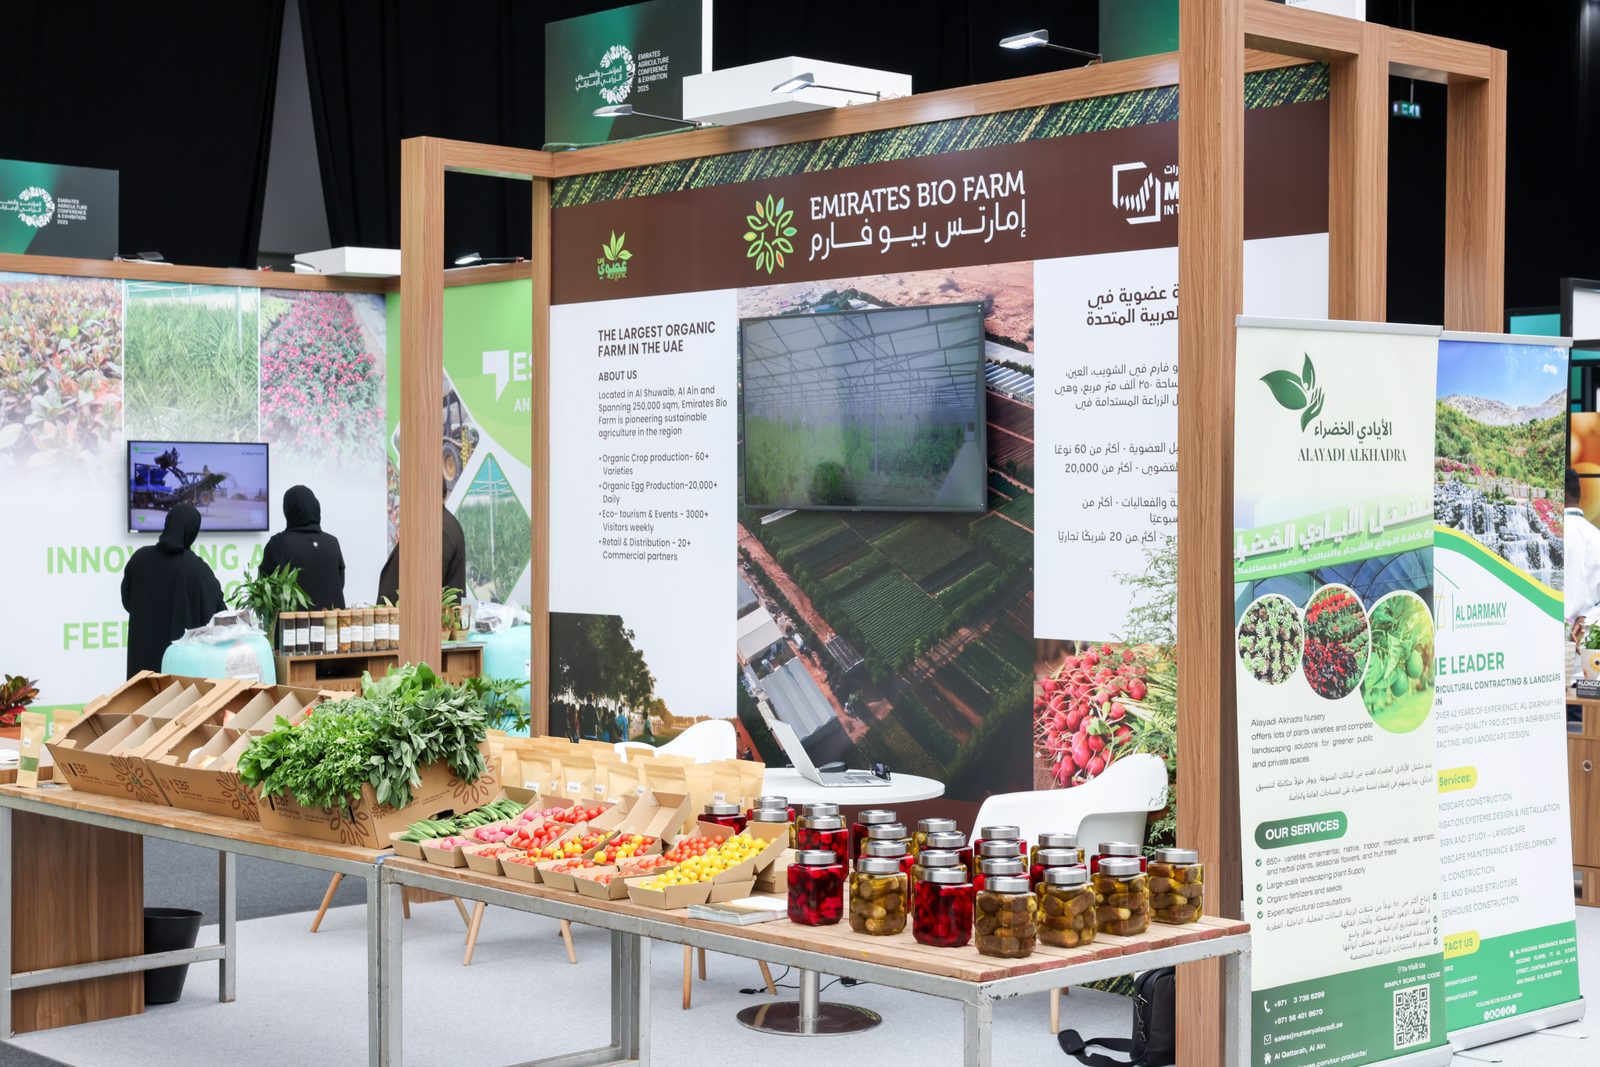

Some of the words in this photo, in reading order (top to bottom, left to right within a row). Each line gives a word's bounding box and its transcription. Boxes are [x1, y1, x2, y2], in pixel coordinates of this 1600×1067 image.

[638, 50, 660, 60] EMIRATES
[638, 56, 669, 68] AGRICULTURE
[638, 65, 668, 76] CONFERENCE
[642, 73, 667, 82] EXHIBITION
[810, 185, 910, 220] EMIRATES
[917, 180, 956, 207] BIO
[963, 170, 1025, 201] FARM
[936, 199, 1026, 248] إمارتس
[809, 219, 872, 261] فارم
[879, 222, 926, 253] بيو
[1088, 289, 1114, 310] في
[1119, 286, 1167, 306] عضوية
[1087, 308, 1135, 326] المتحدة
[1141, 306, 1178, 326] لعربية
[598, 329, 616, 341] THE
[619, 326, 663, 340] LARGEST
[666, 321, 716, 336] ORGANIC
[598, 344, 626, 357] FARM
[629, 343, 638, 355] IN
[642, 341, 660, 354] THE
[663, 340, 684, 352] UAE
[598, 371, 624, 381] ABOUT
[627, 370, 637, 379] US
[1129, 364, 1146, 377] في
[1150, 362, 1169, 376] فارم
[1055, 385, 1077, 396] وهي
[1120, 379, 1135, 390] ألف
[599, 390, 625, 400] Located
[627, 389, 633, 398] in
[636, 389, 642, 397] Al
[644, 387, 676, 398] Shuwaib,
[678, 387, 685, 396] Al
[687, 386, 698, 395] Ain
[701, 385, 715, 394] and
[599, 403, 631, 414] Spanning
[633, 401, 660, 411] 250,000
[662, 403, 680, 411] sqm,
[682, 399, 714, 409] Emirates
[716, 398, 727, 407] Bio
[1076, 398, 1092, 410] في
[1095, 395, 1139, 406] المستدامة
[1142, 394, 1169, 406] الزراعة
[599, 416, 616, 424] Farm
[618, 416, 623, 424] is
[625, 414, 662, 426] pioneering
[665, 412, 707, 422] sustainable
[599, 428, 636, 440] agriculture
[638, 428, 644, 436] in
[646, 427, 657, 436] the
[660, 427, 682, 438] region
[1314, 421, 1354, 439] الخضراء
[1357, 419, 1392, 444] الأيادي
[1075, 444, 1086, 454] 60
[1090, 446, 1101, 456] من
[1105, 442, 1120, 455] أكثر
[1129, 442, 1165, 455] العضوية
[1298, 448, 1344, 462] ALAYADI
[1348, 449, 1406, 462] ALKHADRA
[602, 454, 629, 465] Organic
[632, 454, 648, 463] Crop
[696, 452, 709, 460] 60+
[603, 467, 633, 475] Varieties
[1065, 463, 1098, 474] 20,000
[1102, 466, 1114, 475] من
[1118, 461, 1132, 474] أكثر
[602, 481, 629, 492] Organic
[632, 482, 644, 492] Egg
[603, 495, 620, 505] Daily
[1082, 500, 1094, 509] من
[1098, 496, 1112, 509] أكثر
[1122, 497, 1166, 509] والفعاليات
[620, 510, 646, 518] tourism
[655, 510, 678, 518] Events
[686, 510, 708, 518] 3000+
[603, 523, 628, 531] Visitors
[630, 523, 654, 534] weekly
[630, 538, 670, 547] Distribution
[678, 539, 691, 547] 20+
[1110, 532, 1122, 541] 20
[1125, 534, 1138, 544] من
[603, 551, 645, 560] Commercial
[647, 552, 677, 562] partners
[1456, 605, 1465, 621] AL
[1467, 602, 1507, 619] DARMAKY
[1451, 652, 1505, 674] LEADER
[1436, 683, 1473, 694] RICULTURAL
[1475, 677, 1521, 690] CONTRACTING
[1530, 673, 1561, 684] LANDSCAPE
[1251, 718, 1276, 727] Alayadi
[1278, 716, 1303, 724] Alkhadra
[1304, 713, 1326, 722] Nursery
[1489, 717, 1517, 727] PROJECTS
[1293, 729, 1309, 737] plants
[1311, 726, 1334, 734] varieties
[1348, 721, 1373, 730] complete
[1475, 731, 1507, 743] LANDSCAPE
[1252, 744, 1291, 754] landscaping
[1294, 741, 1318, 750] solutions
[1333, 737, 1354, 747] greener
[1357, 735, 1373, 744] public
[1268, 758, 1288, 767] private
[1439, 774, 1472, 786] Services:
[1466, 793, 1512, 807] CONSTRUCTION
[1465, 813, 1492, 825] SYSTEMS
[1493, 809, 1514, 821] DESIGN
[1520, 803, 1560, 816] INSTALLATION
[1266, 827, 1288, 840] OUR
[1291, 819, 1339, 837] SERVICES
[1468, 831, 1486, 842] STUDY
[1493, 824, 1525, 838] LANDSCAPE
[1467, 846, 1508, 861] MAINTENANCE
[1515, 837, 1557, 852] DEVELOPMENT
[1267, 878, 1298, 890] Large-scale
[1300, 872, 1332, 883] landscaping
[1348, 867, 1365, 876] Supply
[1448, 865, 1495, 881] CONSTRUCTION
[1465, 884, 1484, 896] SHADE
[1486, 878, 1518, 891] STRUCTURE
[1267, 895, 1288, 903] Organic
[1290, 890, 1313, 899] fertilizers
[1326, 885, 1342, 893] seeds
[1267, 908, 1284, 917] Expert
[1286, 903, 1315, 915] agricultural
[1316, 897, 1351, 908] consultations
[1473, 896, 1520, 912] CONSTRUCTION
[1464, 938, 1473, 946] US
[1274, 999, 1287, 1008] +971
[1274, 1015, 1288, 1025] +971
